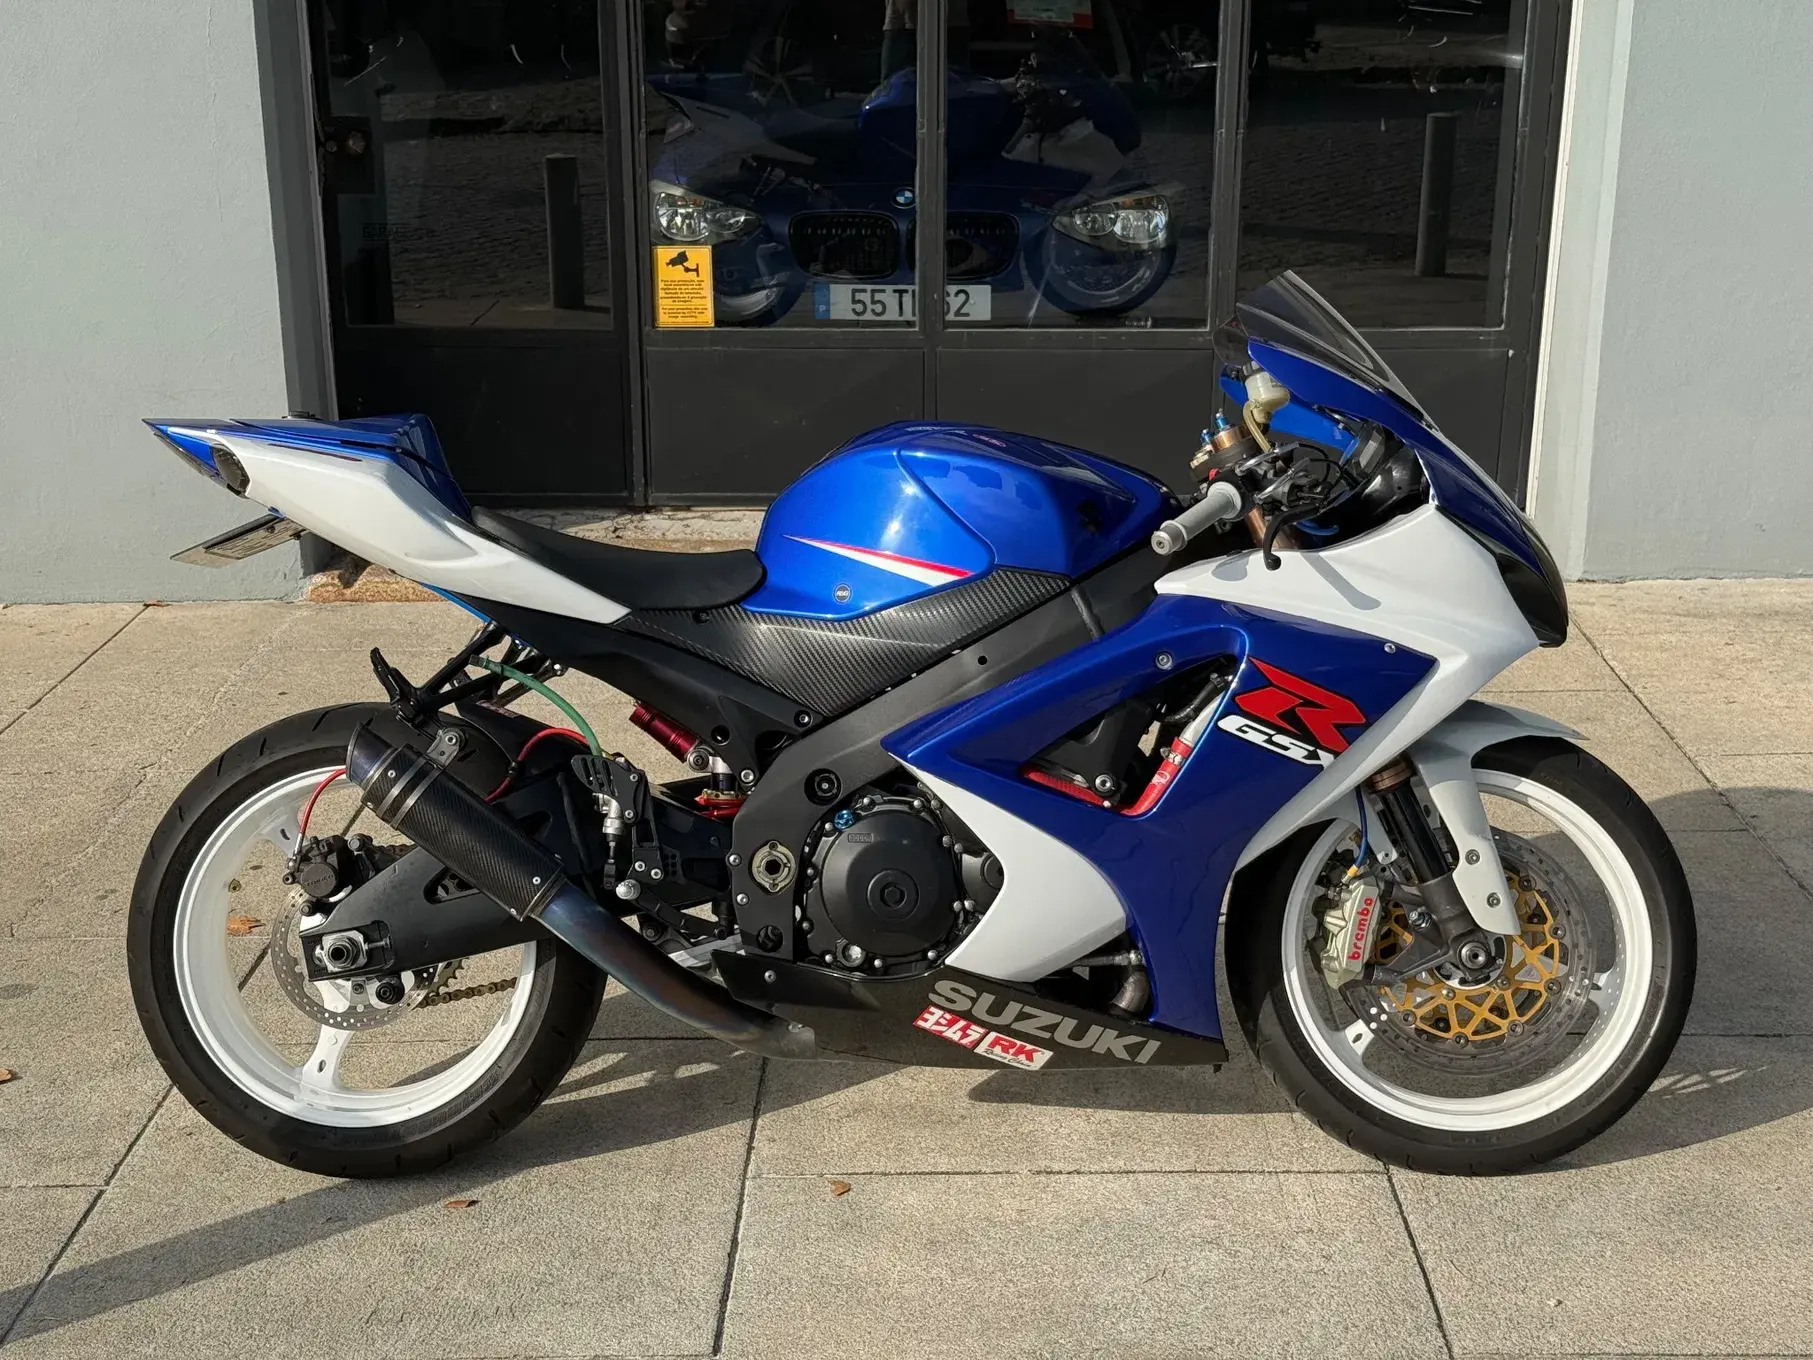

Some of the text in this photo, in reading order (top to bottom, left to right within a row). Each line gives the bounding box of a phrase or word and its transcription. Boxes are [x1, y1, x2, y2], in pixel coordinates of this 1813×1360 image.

[1348, 897, 1373, 961] brembo
[928, 980, 1161, 1064] SUZUKI
[987, 1034, 1041, 1063] RK
